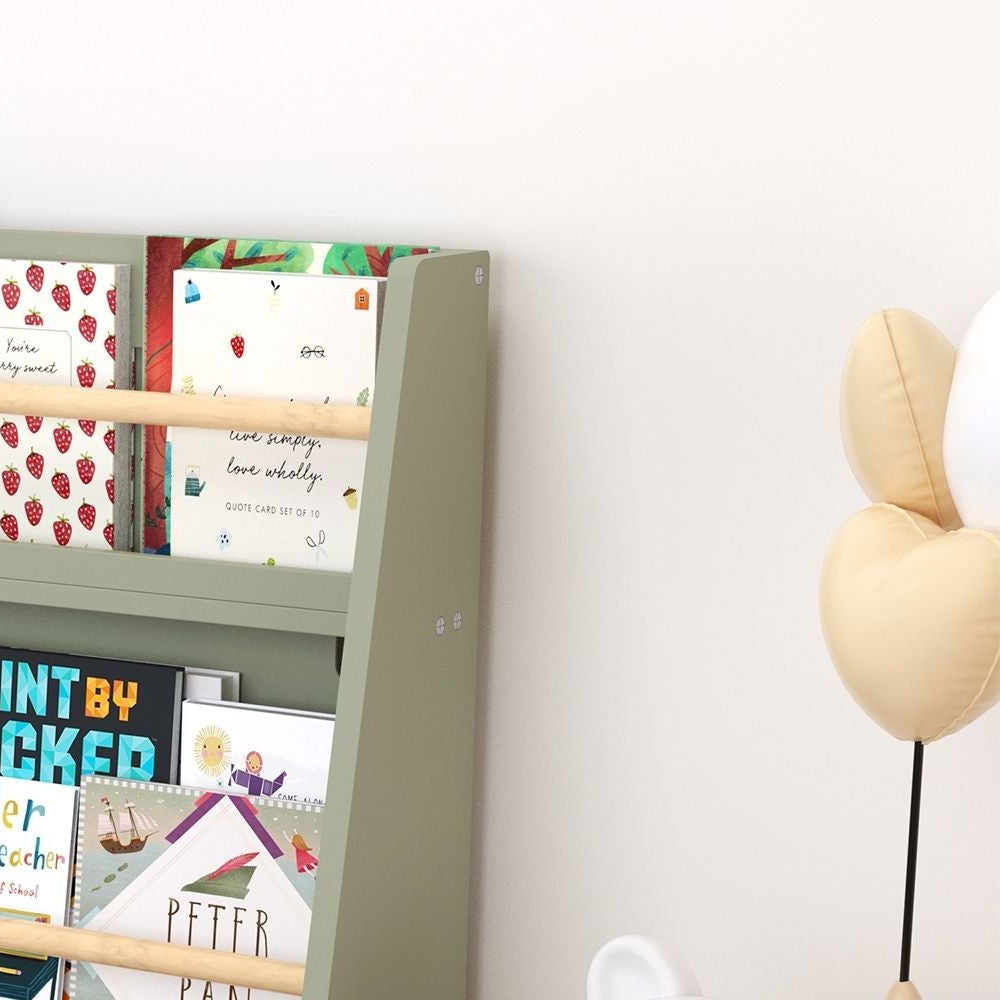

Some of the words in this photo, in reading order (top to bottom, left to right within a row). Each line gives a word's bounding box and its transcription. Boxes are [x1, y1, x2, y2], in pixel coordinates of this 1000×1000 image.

[6, 337, 39, 353] You're
[23, 361, 58, 374] sweet
[227, 456, 261, 475] love
[265, 460, 323, 493] wholly.
[225, 501, 252, 513] QUOTE
[255, 504, 276, 515] CARD
[279, 506, 293, 516] SET
[296, 508, 307, 517] OF
[310, 509, 320, 518] 10
[84, 676, 138, 721] BY
